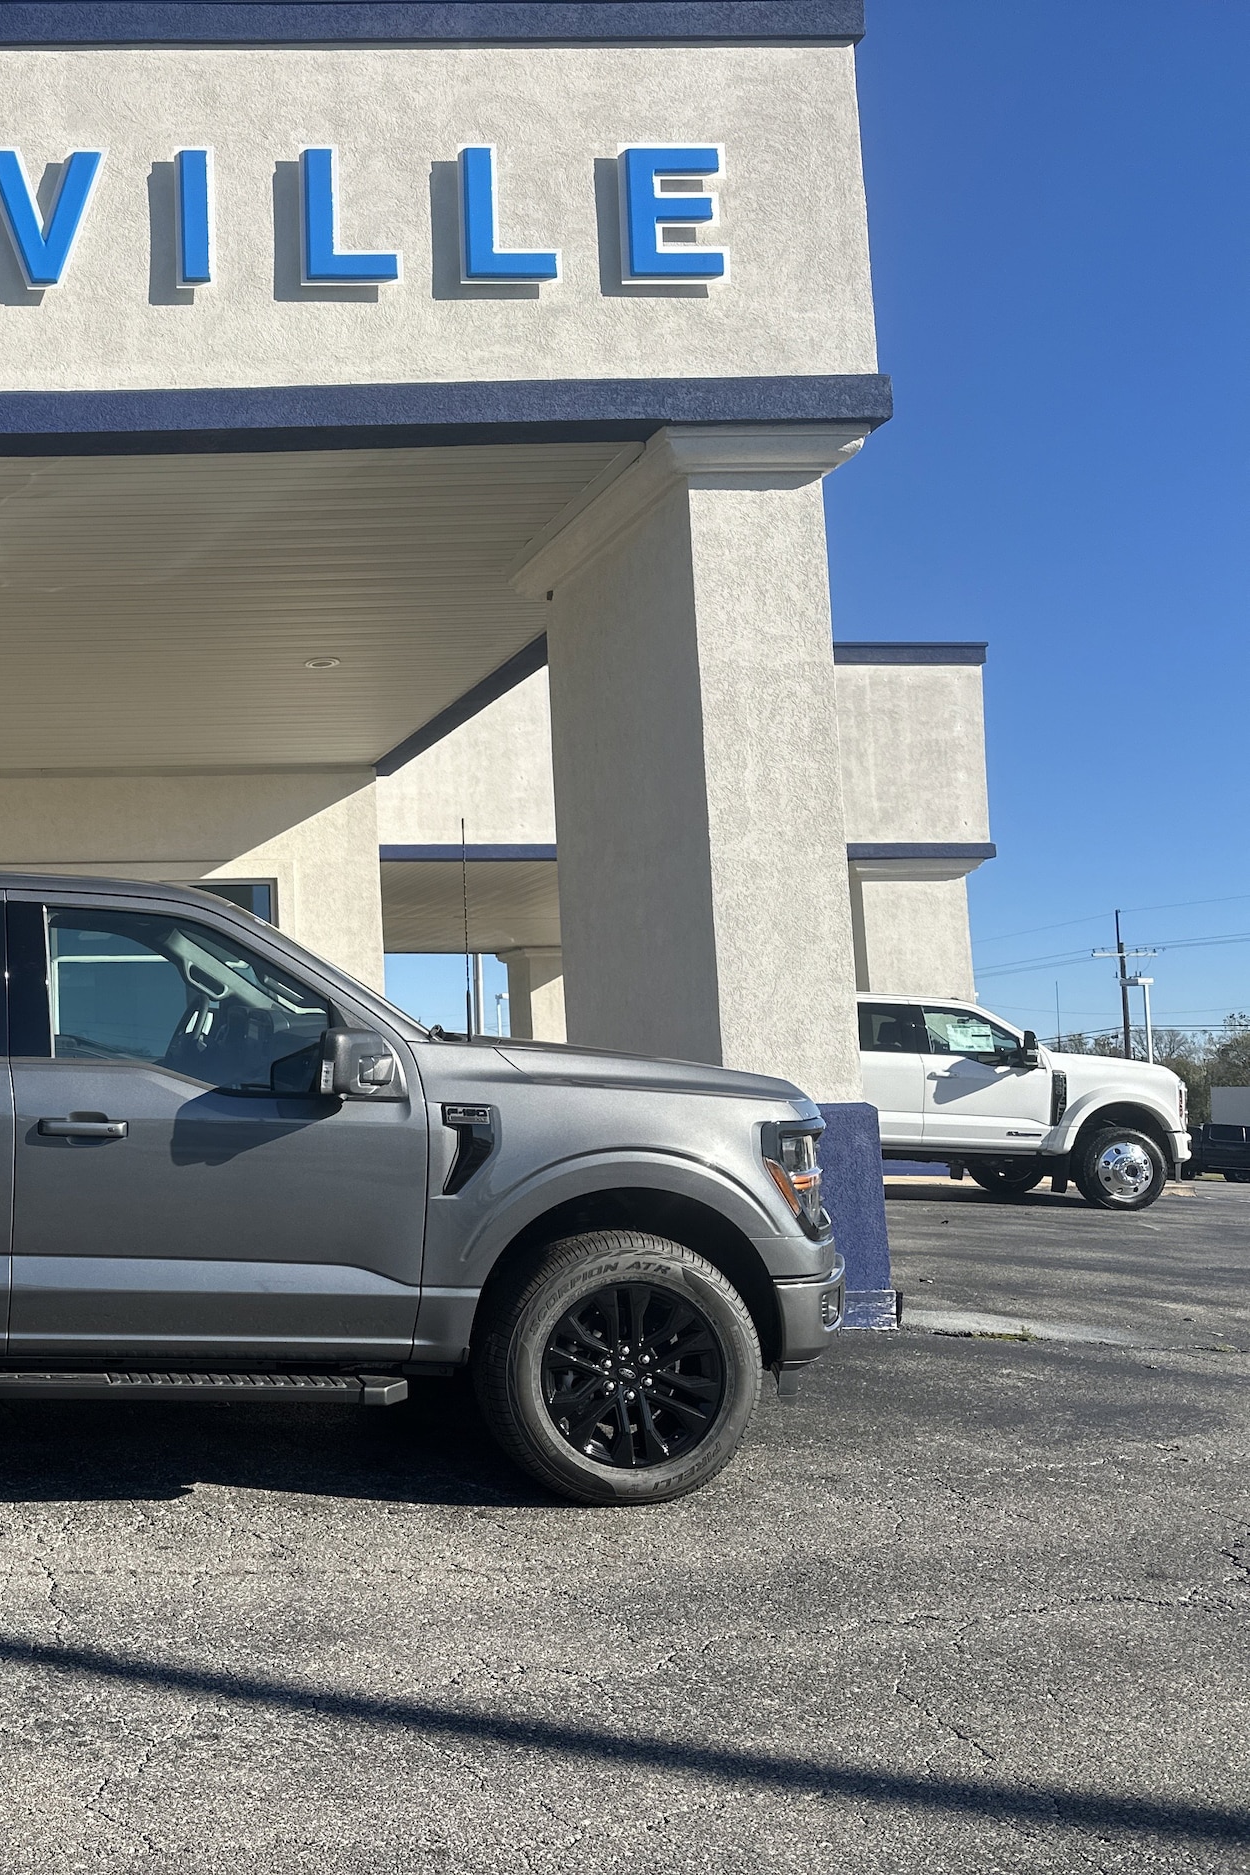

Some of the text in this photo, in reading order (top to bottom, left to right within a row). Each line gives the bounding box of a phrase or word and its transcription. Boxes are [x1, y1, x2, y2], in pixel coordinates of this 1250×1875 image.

[529, 1261, 619, 1336] SCORPION
[625, 1260, 671, 1275] ATR
[652, 1440, 722, 1491] PIRELLI
